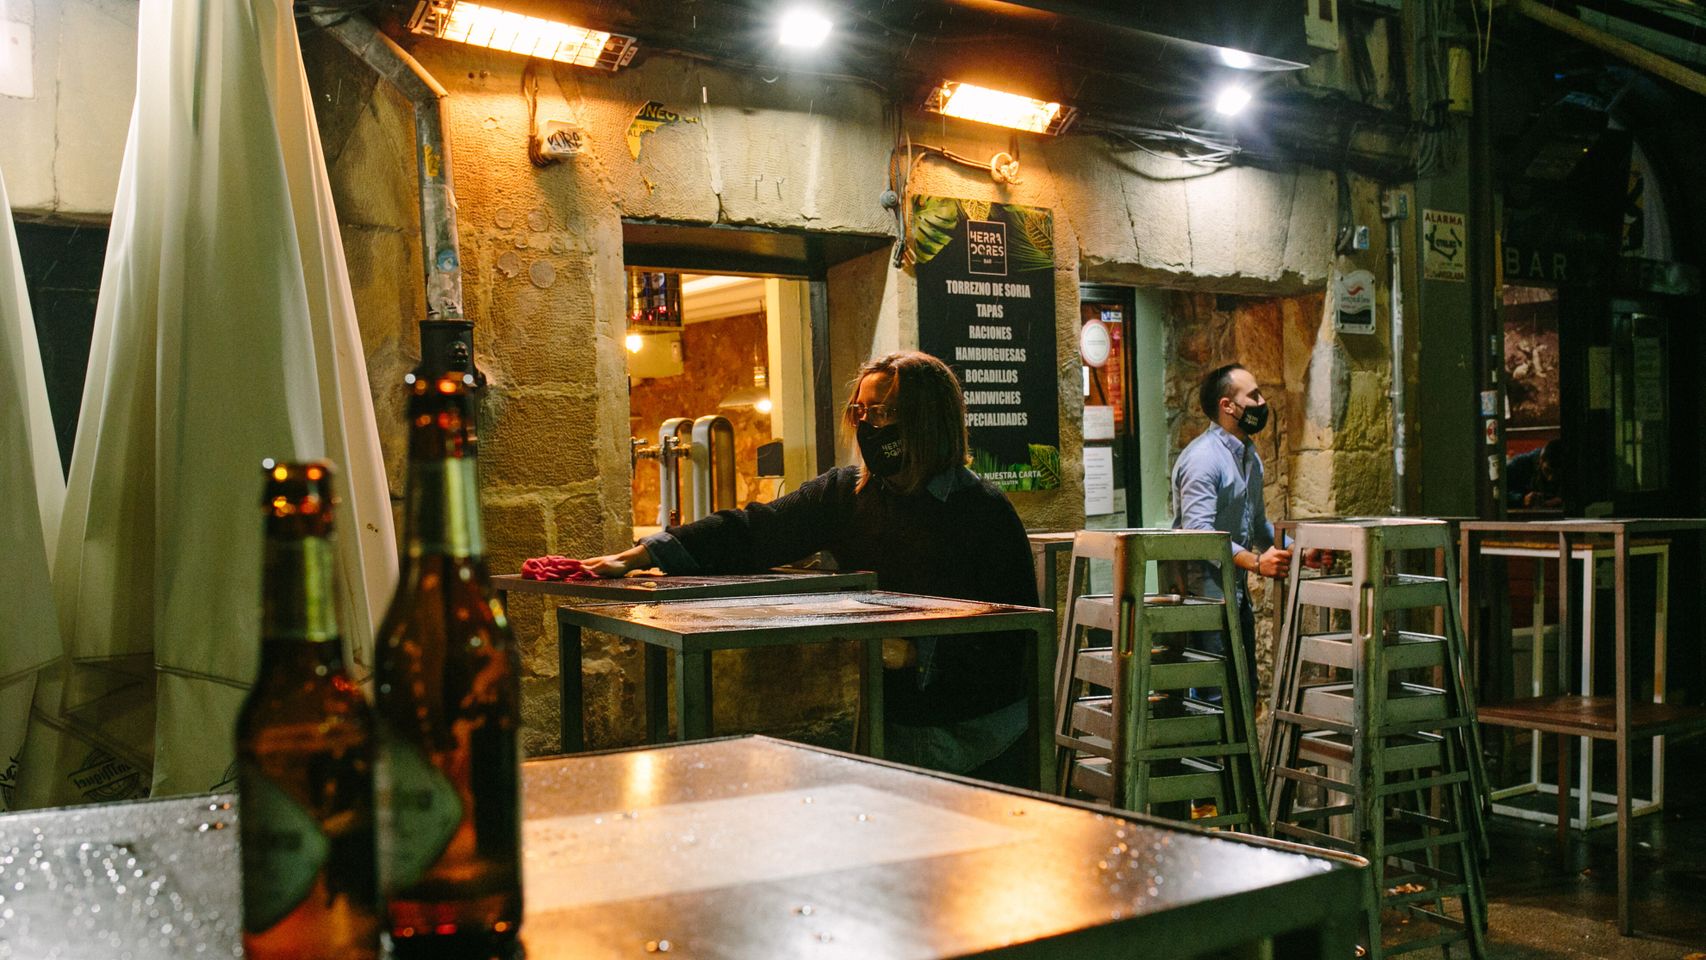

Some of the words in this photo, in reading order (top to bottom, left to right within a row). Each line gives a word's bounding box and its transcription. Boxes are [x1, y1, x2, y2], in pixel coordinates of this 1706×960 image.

[1425, 212, 1463, 226] ALARMA
[970, 230, 1003, 245] HERRA
[970, 243, 1005, 257] DORES
[1505, 246, 1568, 280] BAR
[945, 280, 991, 296] TORREZNO
[992, 282, 1003, 297] DE
[1004, 283, 1031, 298] SORIA
[976, 303, 1004, 318] TAPAS
[969, 325, 1012, 340] RACIONES
[955, 346, 1027, 362] HAMBURGUESAS
[965, 369, 1018, 383] BOCADILLOS
[963, 391, 1022, 405] SANDWICHES
[963, 412, 1028, 427] SPECIALIDADES
[984, 471, 1018, 480] NUESTRA
[1018, 470, 1042, 479] CARTA
